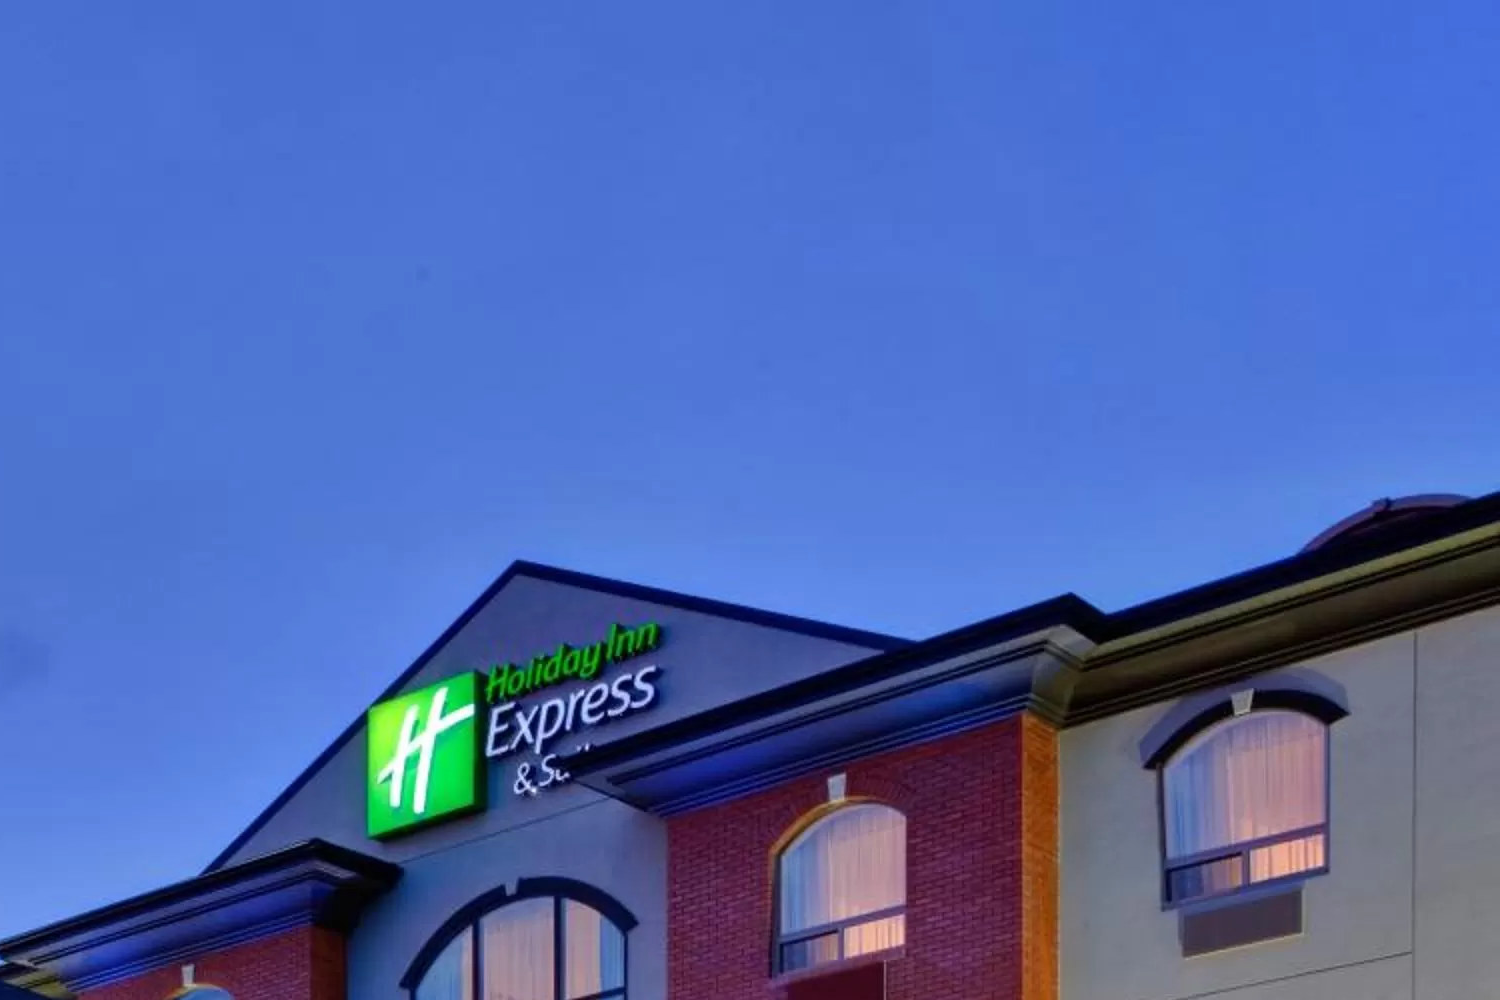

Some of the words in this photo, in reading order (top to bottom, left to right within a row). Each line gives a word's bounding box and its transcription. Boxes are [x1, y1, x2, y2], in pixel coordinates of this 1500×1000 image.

[486, 642, 601, 702] Holiday
[606, 622, 659, 661] Inn
[376, 686, 475, 815] H
[485, 665, 657, 757] Express
[513, 762, 537, 795] &
